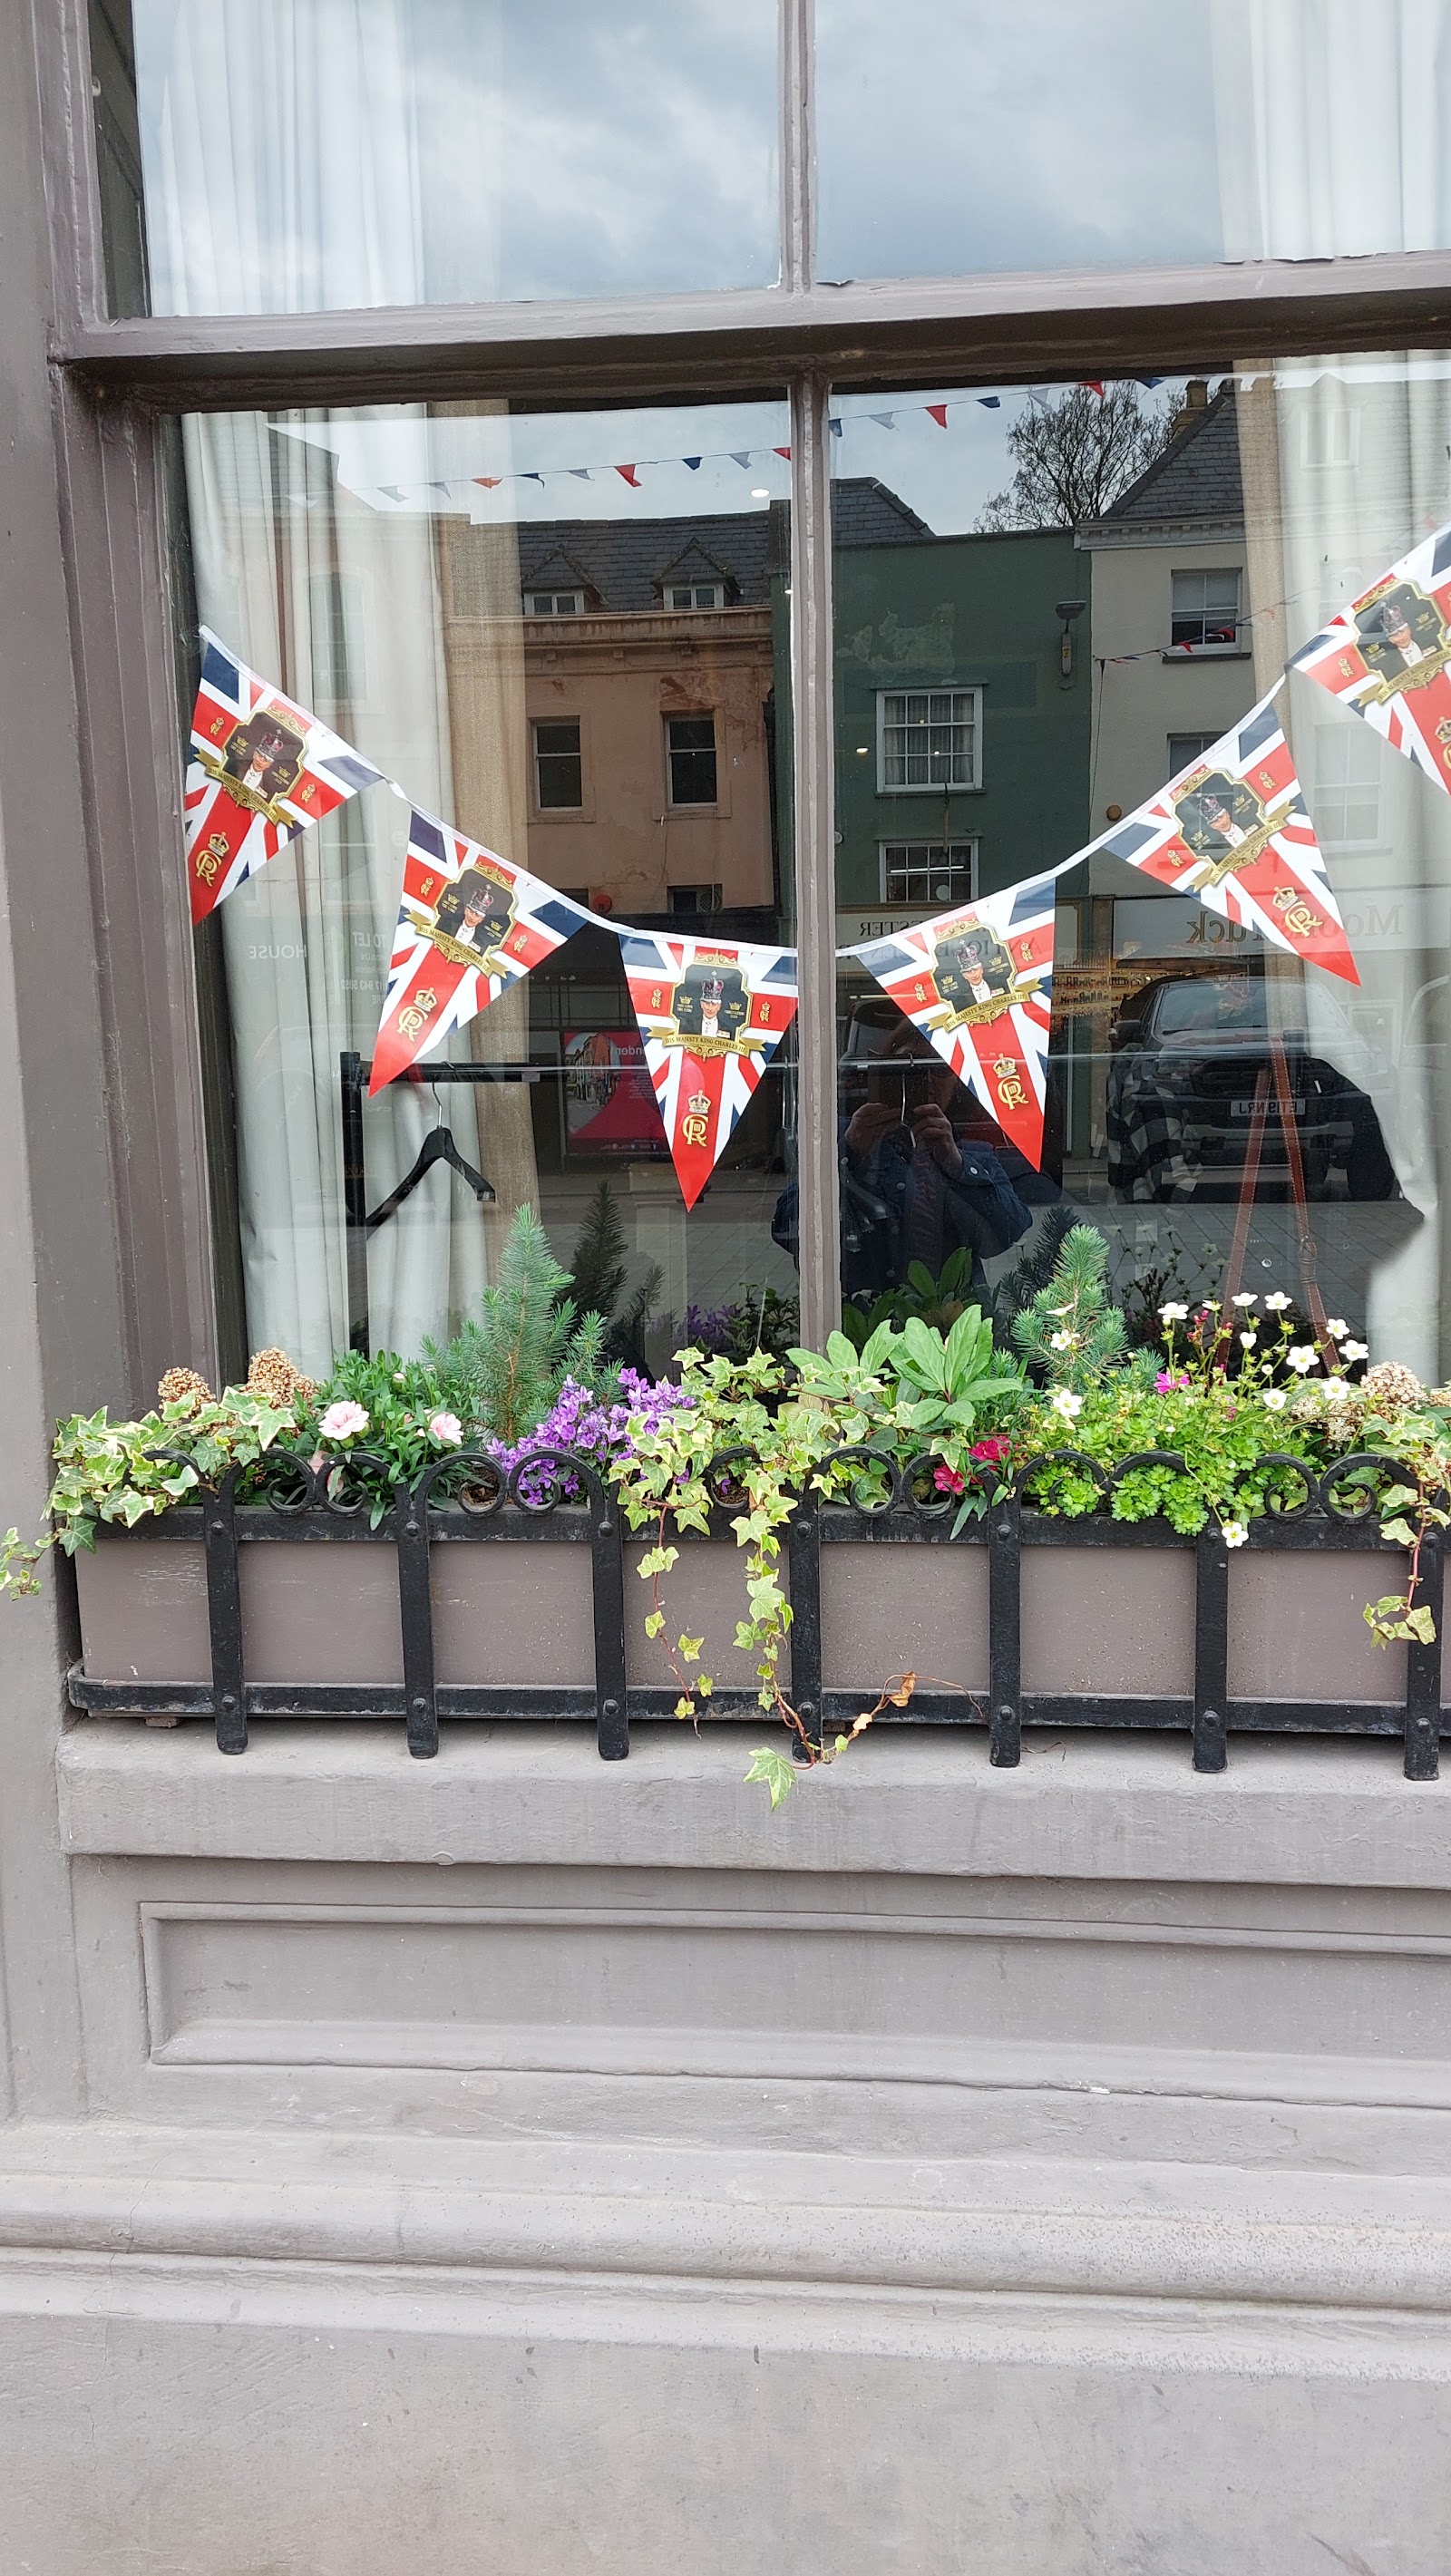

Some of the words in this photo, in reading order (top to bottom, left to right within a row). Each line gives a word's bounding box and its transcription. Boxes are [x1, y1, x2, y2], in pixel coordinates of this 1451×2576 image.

[1218, 853, 1237, 872] MAJESTY
[1237, 842, 1251, 854] KING
[430, 928, 451, 944] MAJESTY
[451, 938, 463, 952] KING
[463, 948, 484, 966] CHARLES
[956, 1007, 978, 1021] MAJESTY
[979, 1002, 992, 1011] KING
[992, 996, 1017, 1006] CHARLES
[715, 1040, 738, 1050] CHARLES
